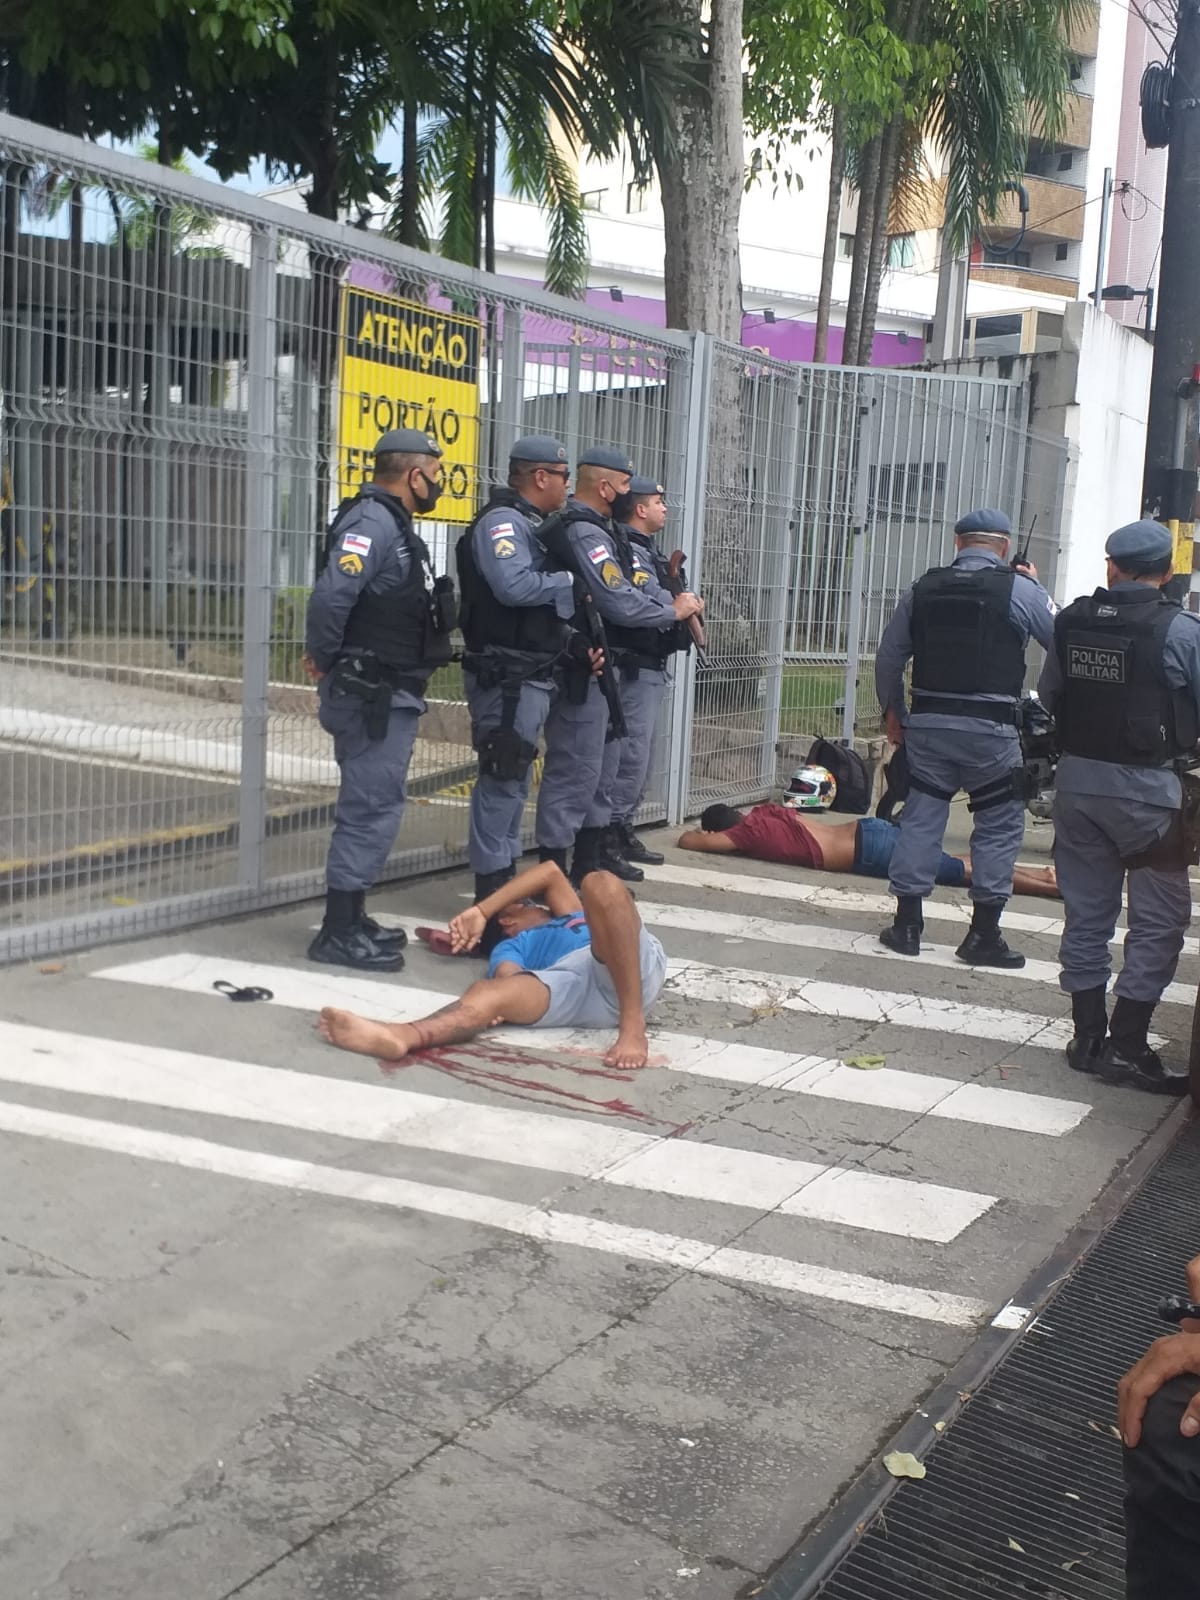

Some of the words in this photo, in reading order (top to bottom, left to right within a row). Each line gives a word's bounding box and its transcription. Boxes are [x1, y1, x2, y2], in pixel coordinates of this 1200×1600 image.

[358, 309, 467, 369] ATENÇÃO
[358, 391, 460, 445] PORTÃO
[1071, 663, 1120, 680] MILITAR
